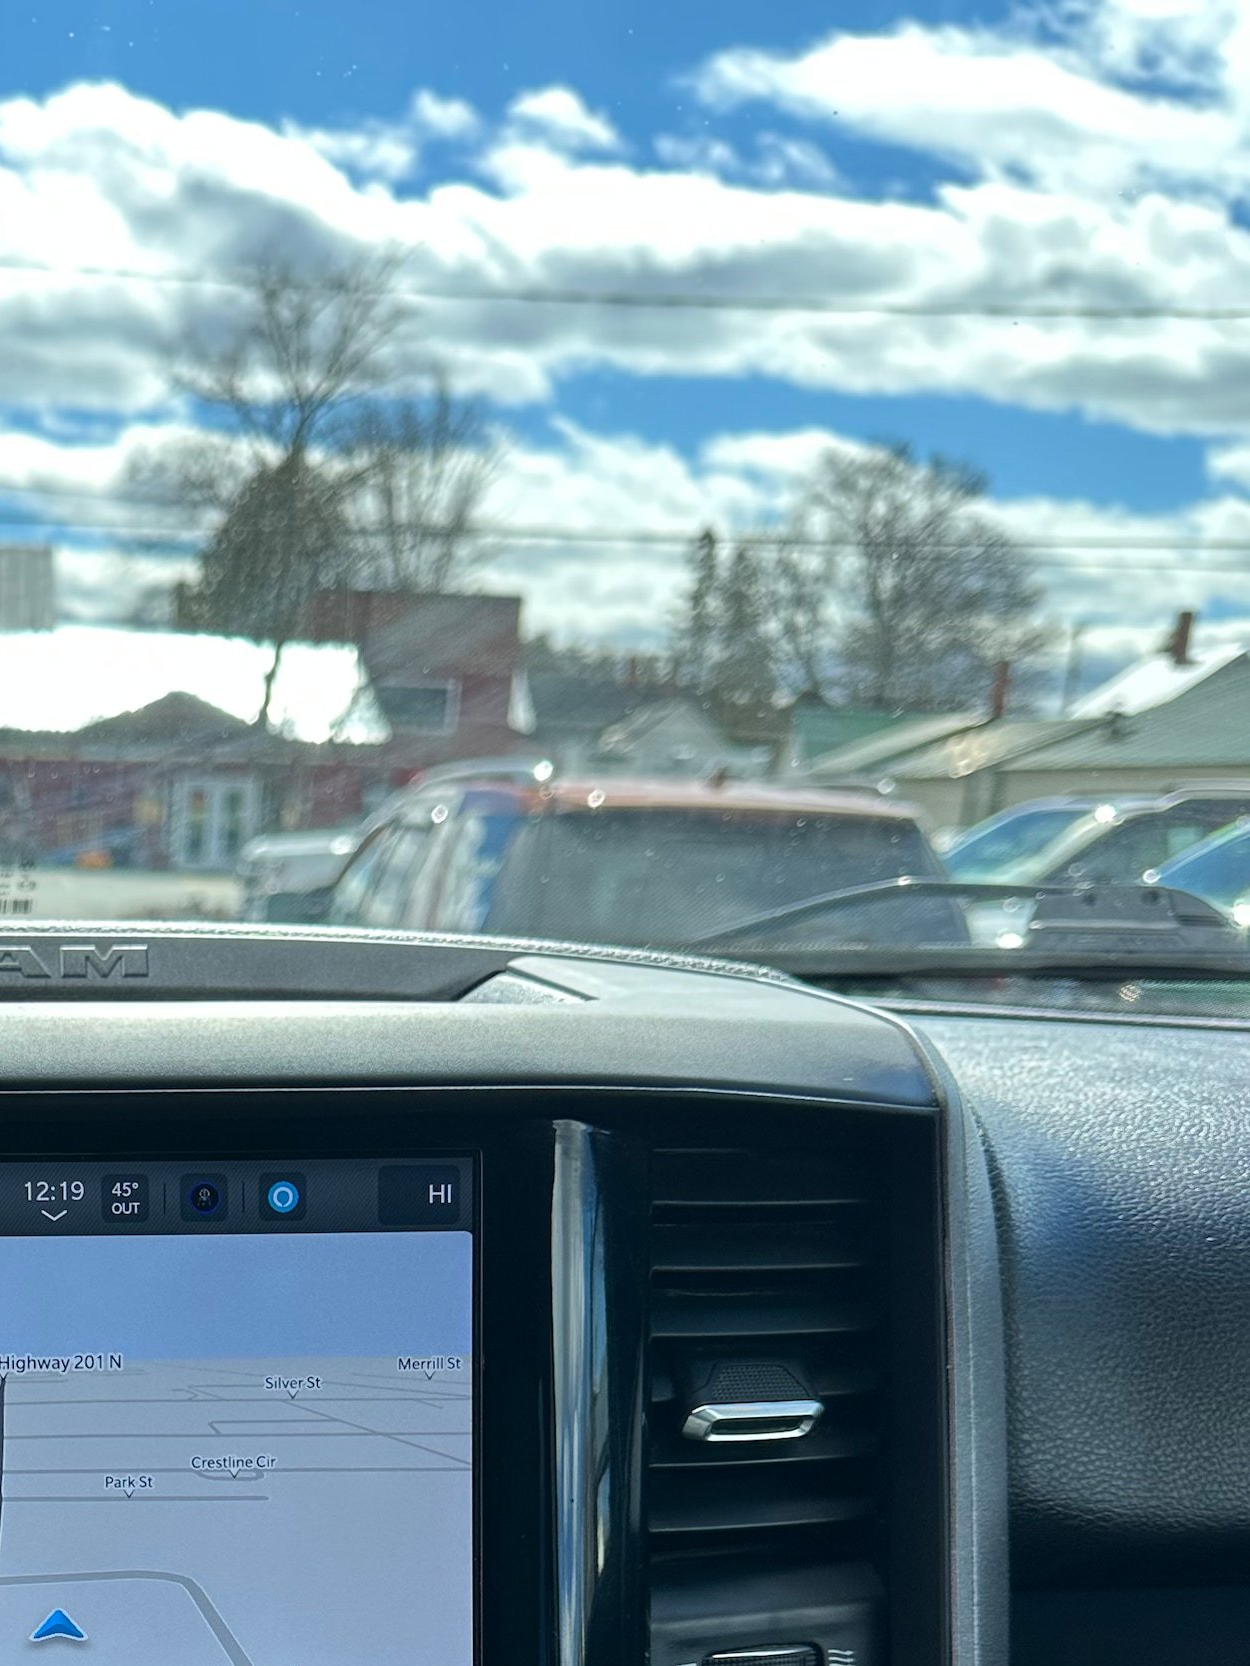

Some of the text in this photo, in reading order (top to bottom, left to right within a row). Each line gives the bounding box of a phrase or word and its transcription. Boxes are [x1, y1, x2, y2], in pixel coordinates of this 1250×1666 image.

[24, 1181, 85, 1201] 12:19
[111, 1182, 139, 1197] 45°
[429, 1184, 452, 1203] HI
[111, 1202, 140, 1214] OUT
[74, 1355, 104, 1370] 201
[109, 1355, 122, 1369] N
[398, 1357, 461, 1370] Merrill St
[264, 1377, 321, 1389] Silver St
[192, 1455, 276, 1469] Crestline Cir
[105, 1476, 153, 1489] Park St
